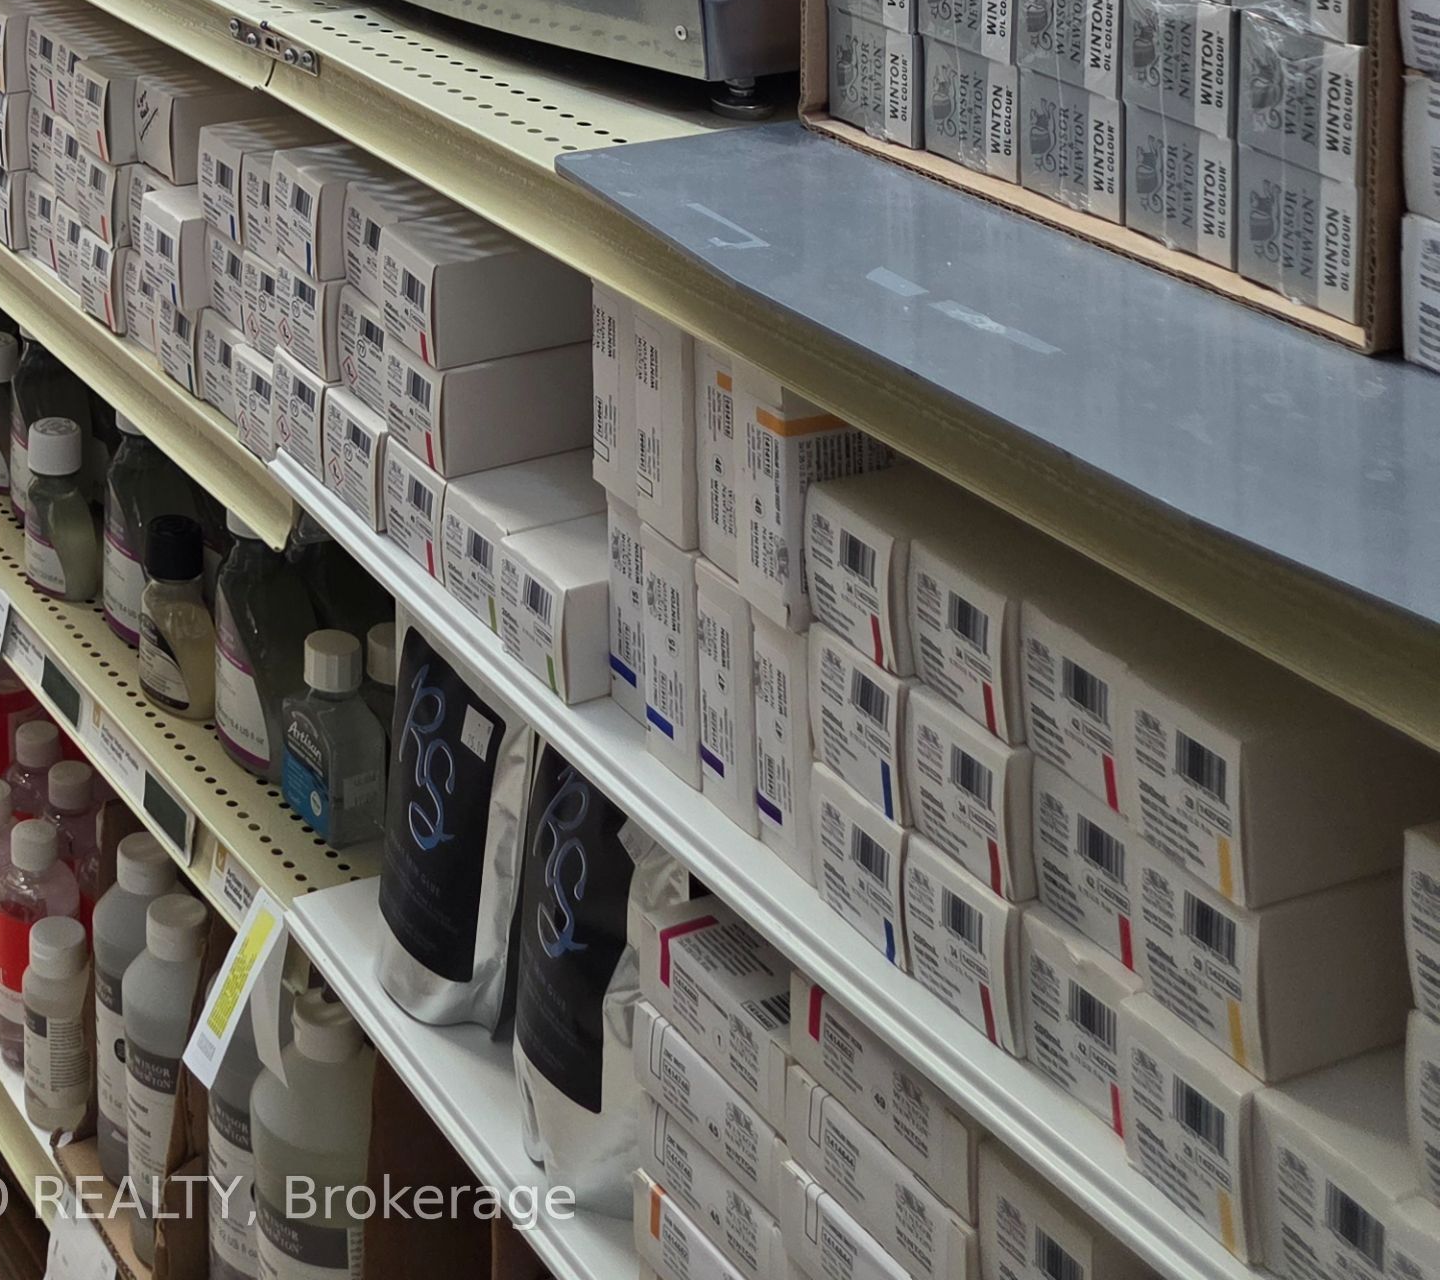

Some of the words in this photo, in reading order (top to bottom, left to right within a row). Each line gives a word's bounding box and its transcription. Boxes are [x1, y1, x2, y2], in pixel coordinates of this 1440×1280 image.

[890, 53, 901, 120] WINTON
[1201, 29, 1214, 106] WINTON
[1324, 207, 1340, 289] WINTON
[288, 720, 323, 760] Artisan
